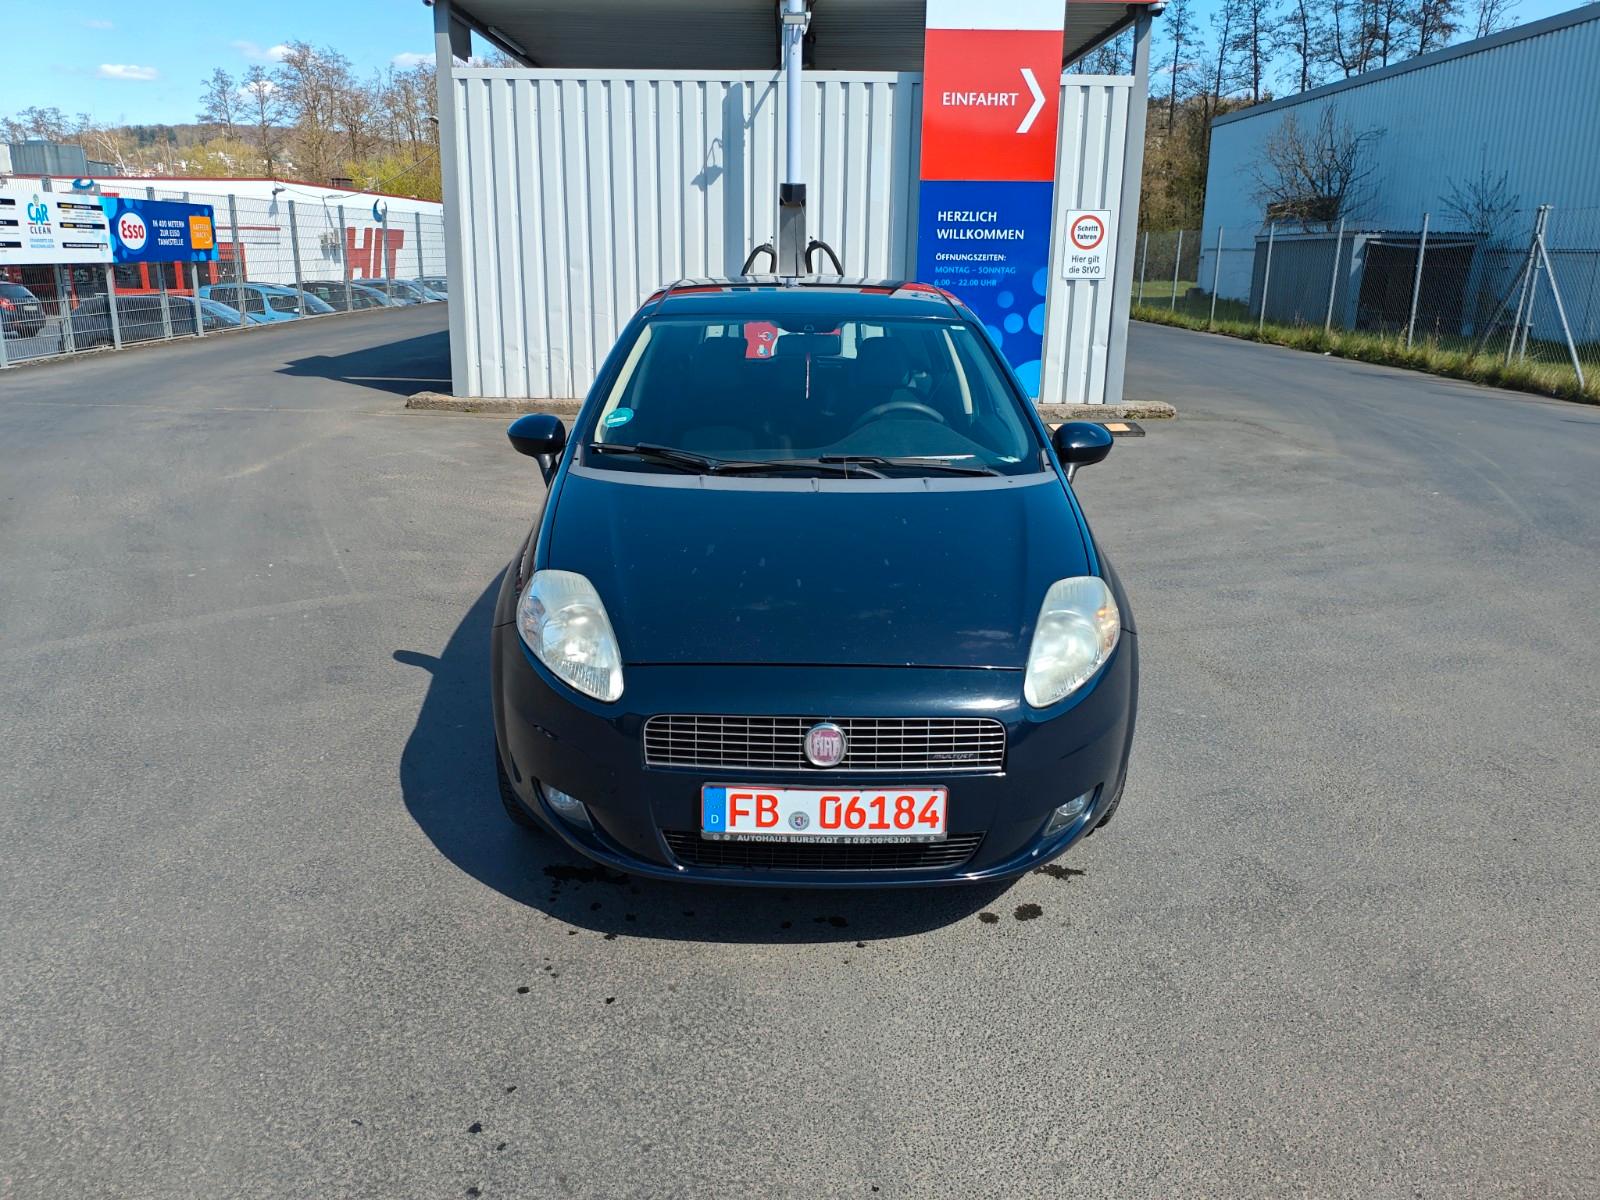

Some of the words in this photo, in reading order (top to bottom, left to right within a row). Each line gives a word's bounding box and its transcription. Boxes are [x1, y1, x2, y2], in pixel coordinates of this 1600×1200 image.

[942, 91, 1019, 106] EINFAHRT
[27, 202, 50, 225] CAR
[937, 210, 997, 222] HERZLICH
[30, 226, 52, 235] CLEAN
[936, 228, 1025, 240] WILLKOMMEN
[157, 238, 185, 246] TANKSTELLE
[346, 227, 405, 280] HIT
[935, 252, 1007, 261] ÖFFNUNGSZEITEN:
[1071, 255, 1086, 263] Hier
[1087, 255, 1100, 264] gilt
[934, 266, 970, 274] MONTAG
[978, 266, 1016, 274] SONNTAG
[1081, 266, 1100, 274] StVO
[934, 279, 951, 287] 6.00
[958, 279, 979, 287] 22.00
[980, 279, 997, 287] UHR
[813, 735, 841, 757] FIAT
[710, 814, 719, 824] D
[729, 793, 779, 828] FB
[819, 795, 940, 830] 06184
[736, 834, 788, 843] AUTOHAUS
